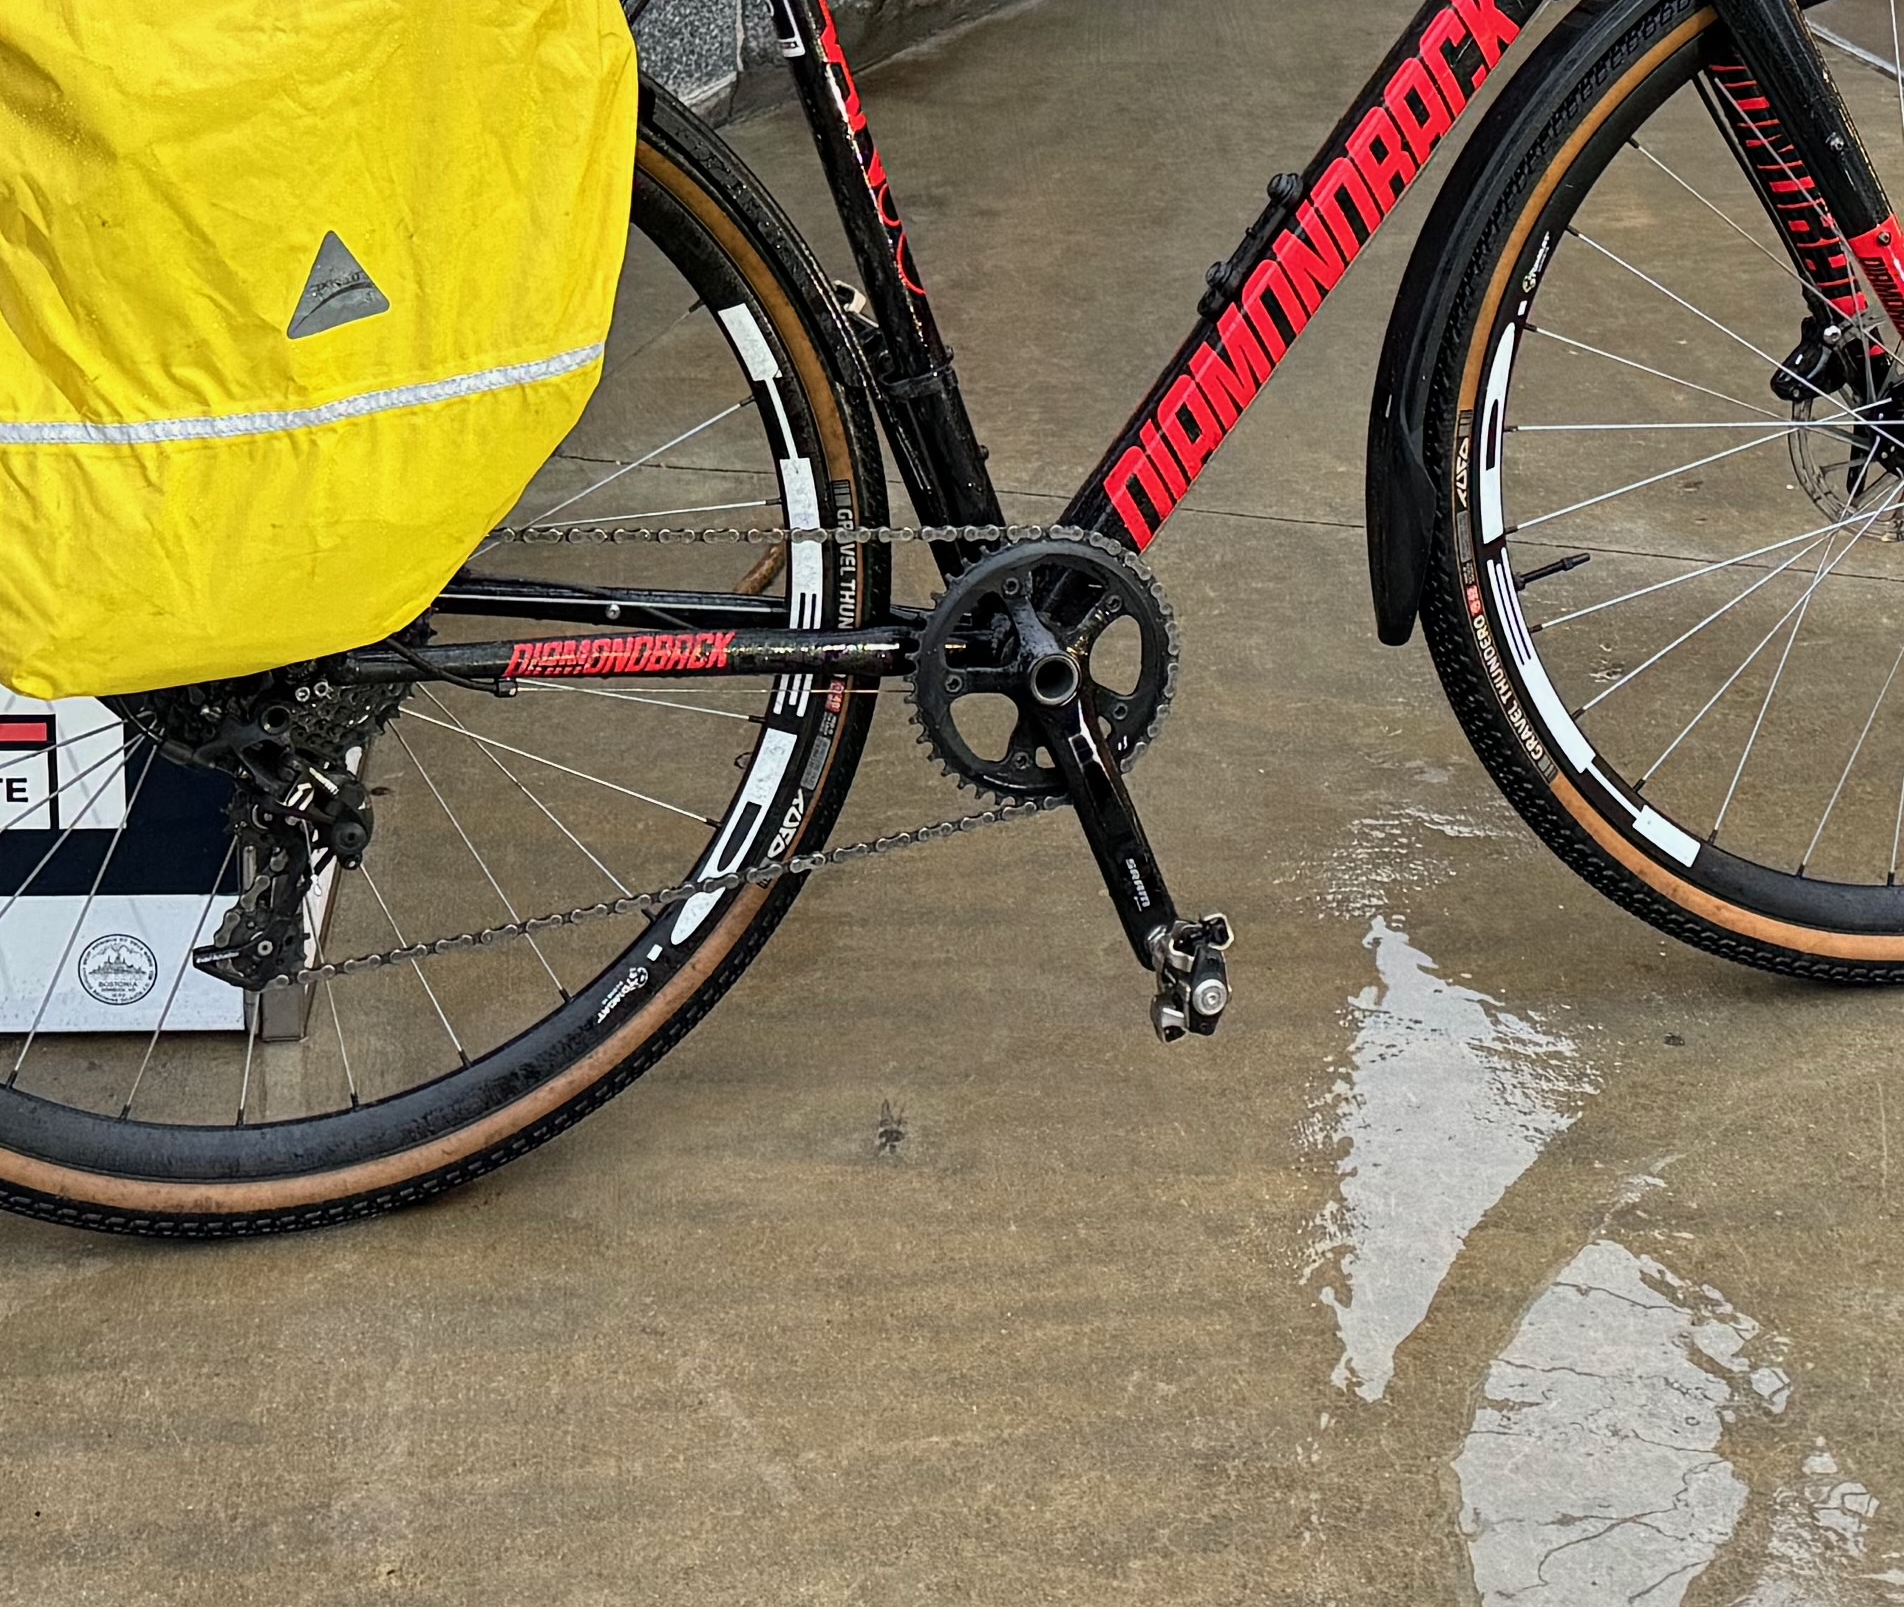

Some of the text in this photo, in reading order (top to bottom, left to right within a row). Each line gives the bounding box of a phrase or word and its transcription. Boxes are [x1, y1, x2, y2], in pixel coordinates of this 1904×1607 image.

[836, 508, 857, 577] GRVEL
[502, 631, 737, 679] DIAMONDBACK
[1501, 700, 1543, 760] GRAVEL
